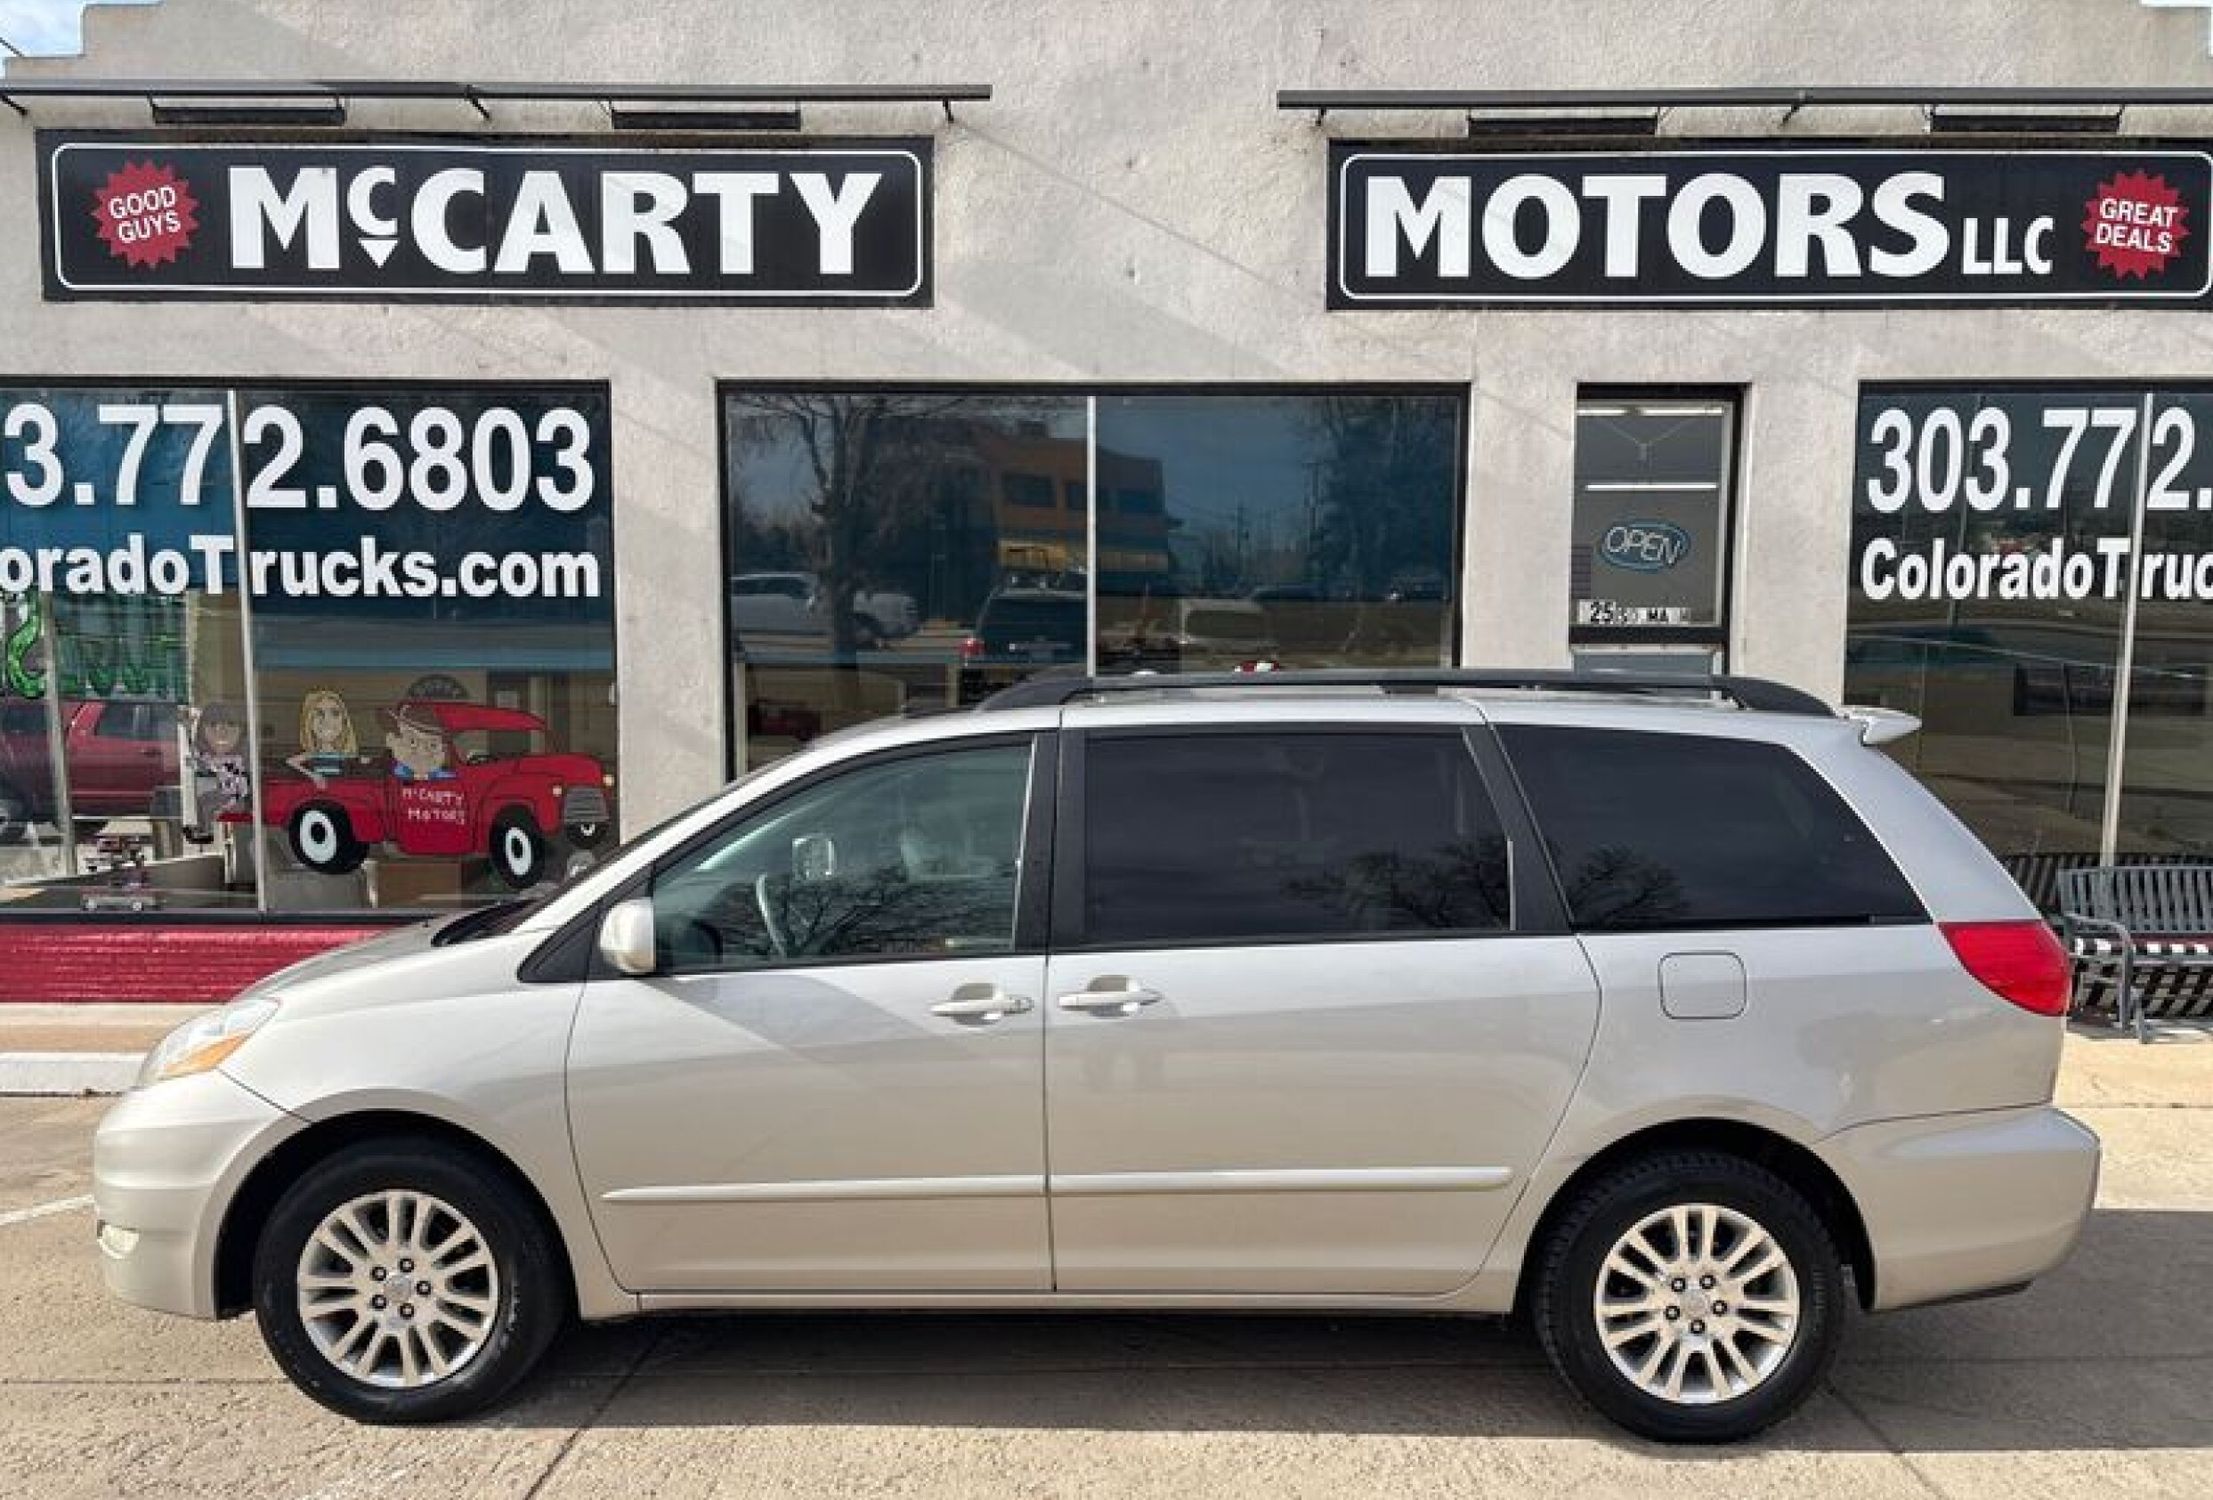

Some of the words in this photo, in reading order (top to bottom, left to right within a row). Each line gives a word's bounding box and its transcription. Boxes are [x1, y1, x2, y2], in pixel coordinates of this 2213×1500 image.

[109, 185, 176, 219] GOOD
[2099, 197, 2179, 229] GREAT
[117, 209, 181, 244] GUYS
[1365, 172, 1950, 280] MOTORS
[1962, 215, 2054, 275] LLC
[2095, 222, 2173, 254] DEALS
[1607, 526, 1681, 566] OPEN
